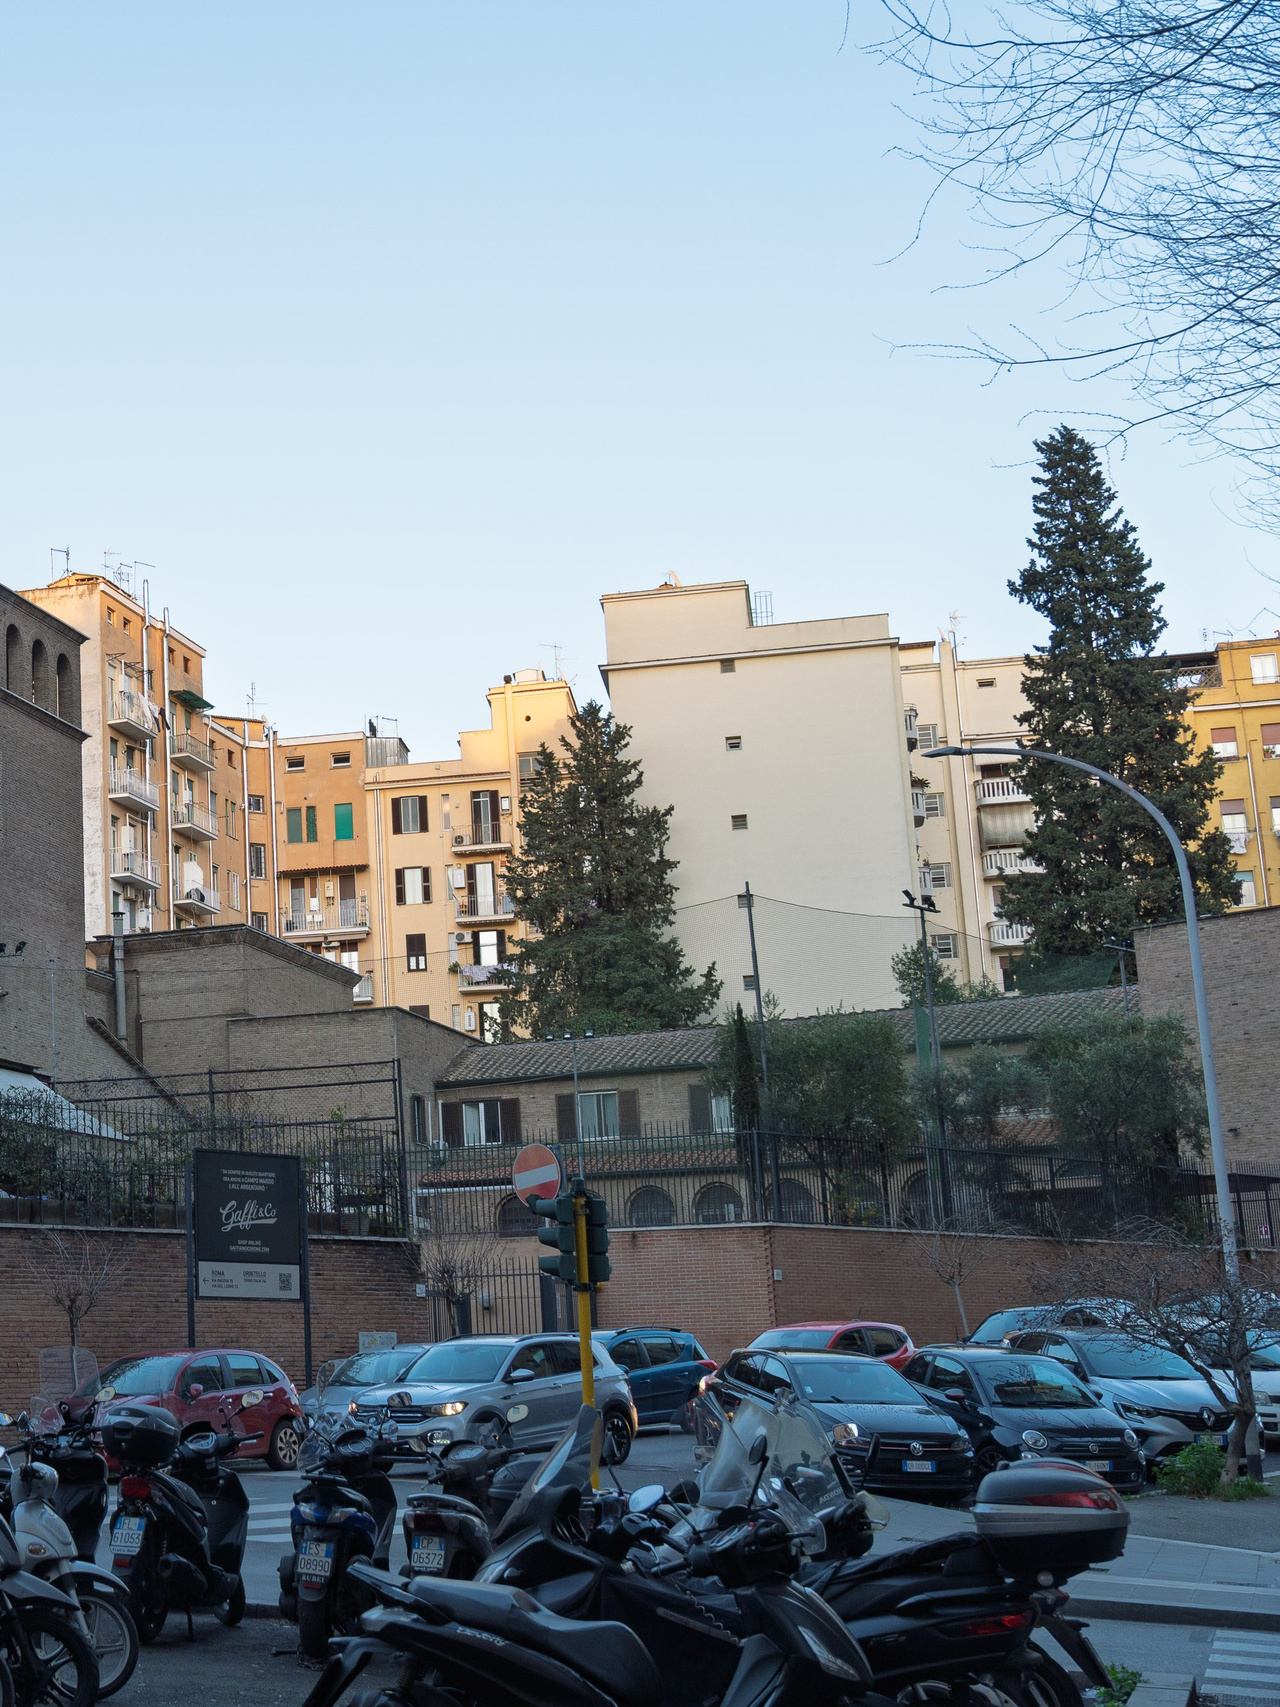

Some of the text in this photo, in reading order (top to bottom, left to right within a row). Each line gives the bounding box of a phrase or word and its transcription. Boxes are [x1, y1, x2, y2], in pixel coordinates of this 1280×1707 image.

[122, 1518, 131, 1529] FL
[113, 1531, 141, 1545] 61053
[420, 1537, 433, 1548] CP
[308, 1543, 320, 1556] ES
[299, 1557, 330, 1572] 08990
[413, 1554, 443, 1566] 06372
